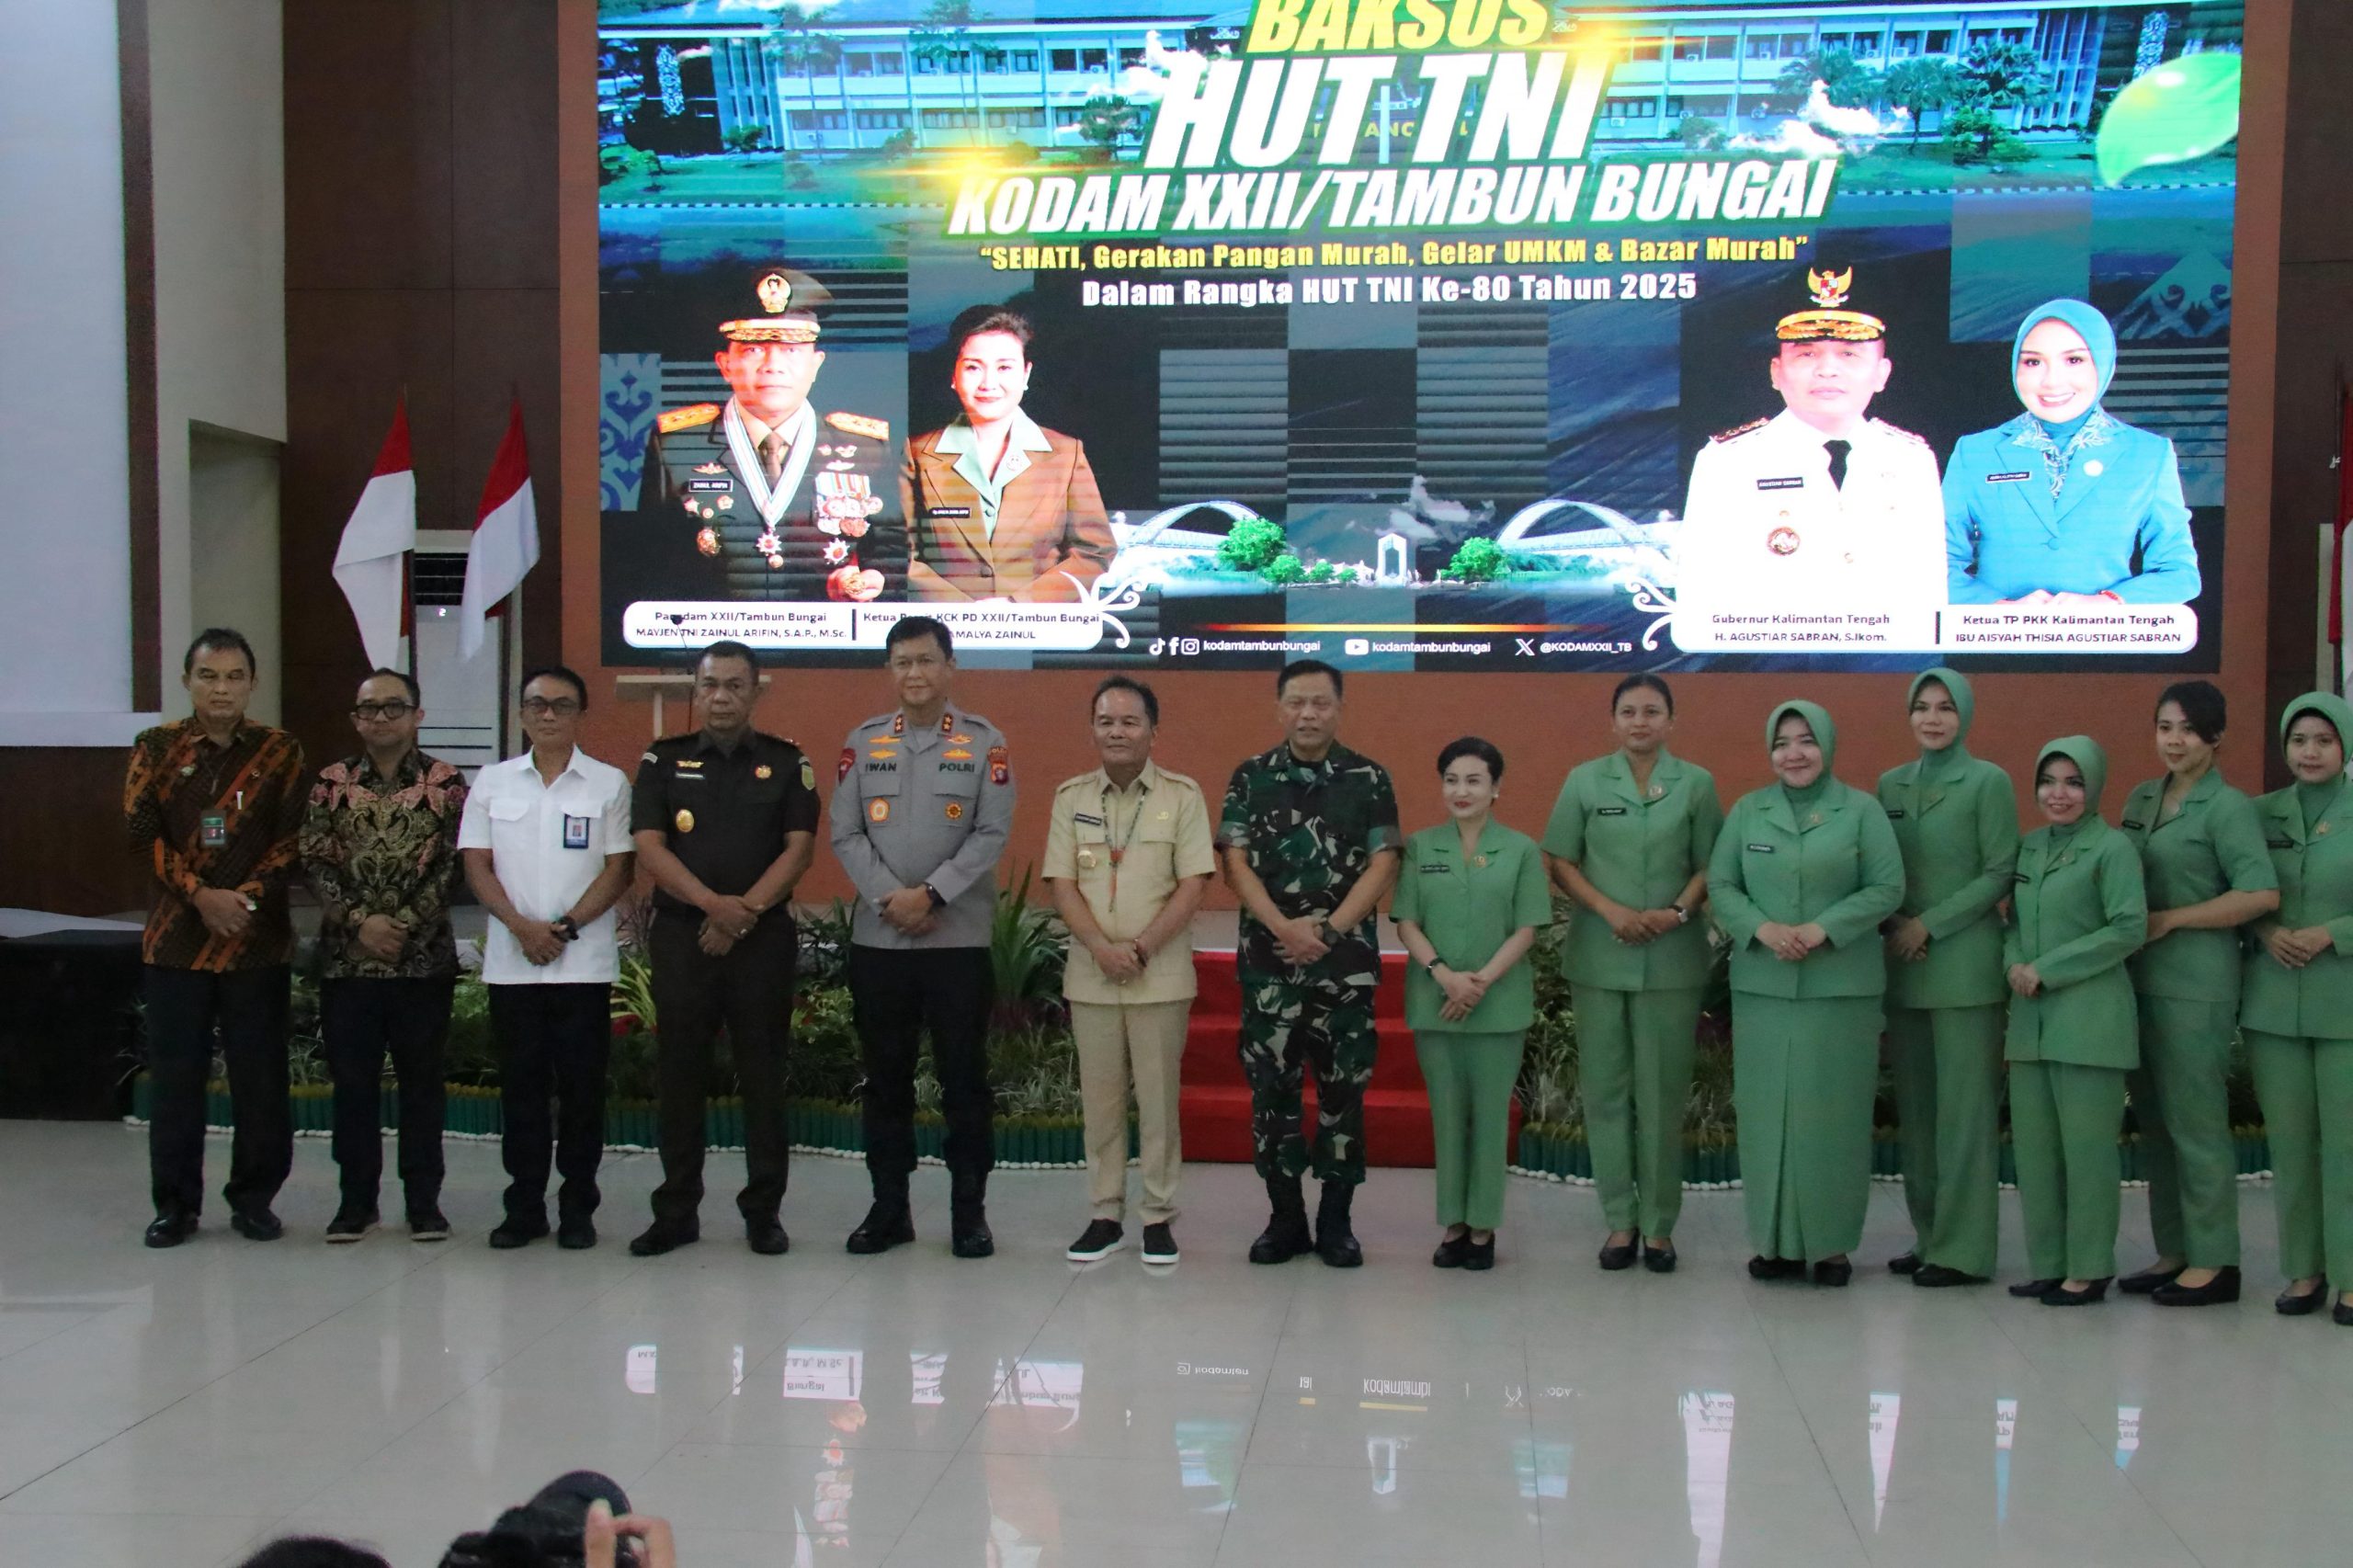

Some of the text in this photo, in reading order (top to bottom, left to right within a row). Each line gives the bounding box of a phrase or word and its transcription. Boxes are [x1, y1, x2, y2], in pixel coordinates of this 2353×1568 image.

[1246, 0, 1548, 52] BAKSOS
[1144, 51, 1610, 168] HUT TNI
[947, 159, 1837, 234] KODAM XXII/TAMBUN BUNGAI
[1094, 245, 1206, 269] Gerakan
[1213, 244, 1313, 271] Pangan
[1321, 242, 1415, 267] Murah,
[1422, 241, 1496, 265] Gelar
[1504, 239, 1586, 264] UMKM
[1594, 241, 1614, 263] &
[1620, 238, 1698, 262] Bazar
[1083, 273, 1697, 307] Dalam Rangka HUT TNI Ke-80 Tahun 2025
[655, 612, 826, 624] Padam XXII/Tambun Bungai
[864, 613, 896, 622] Ketua
[962, 613, 977, 622] PD
[981, 613, 1056, 623] XXII/Tambun
[1061, 613, 1099, 625] Bungai
[1712, 614, 1890, 626] Gubernur Kalimantan Tengah
[1963, 615, 2175, 627] Ketua TP PKK Kalimantan Tengah
[680, 629, 698, 637] TNI
[701, 629, 741, 637] ZAINUL
[820, 629, 847, 638] M.Sc.
[995, 631, 1036, 639] ZAINUL
[1715, 632, 1726, 642] H.
[1730, 632, 1787, 642] AGUSTIAR
[1790, 632, 1842, 642] SABRAN,
[1956, 634, 1975, 642] IBU
[1978, 634, 2021, 642] AISYAH
[2067, 634, 2127, 642] AGUSTIAR
[2130, 634, 2181, 642] SABRAN
[1203, 640, 1320, 653] kodamtambunbungai
[1372, 642, 1491, 654] kodamtambunbungai
[865, 762, 897, 773] IWAN
[938, 763, 975, 773] POLRI
